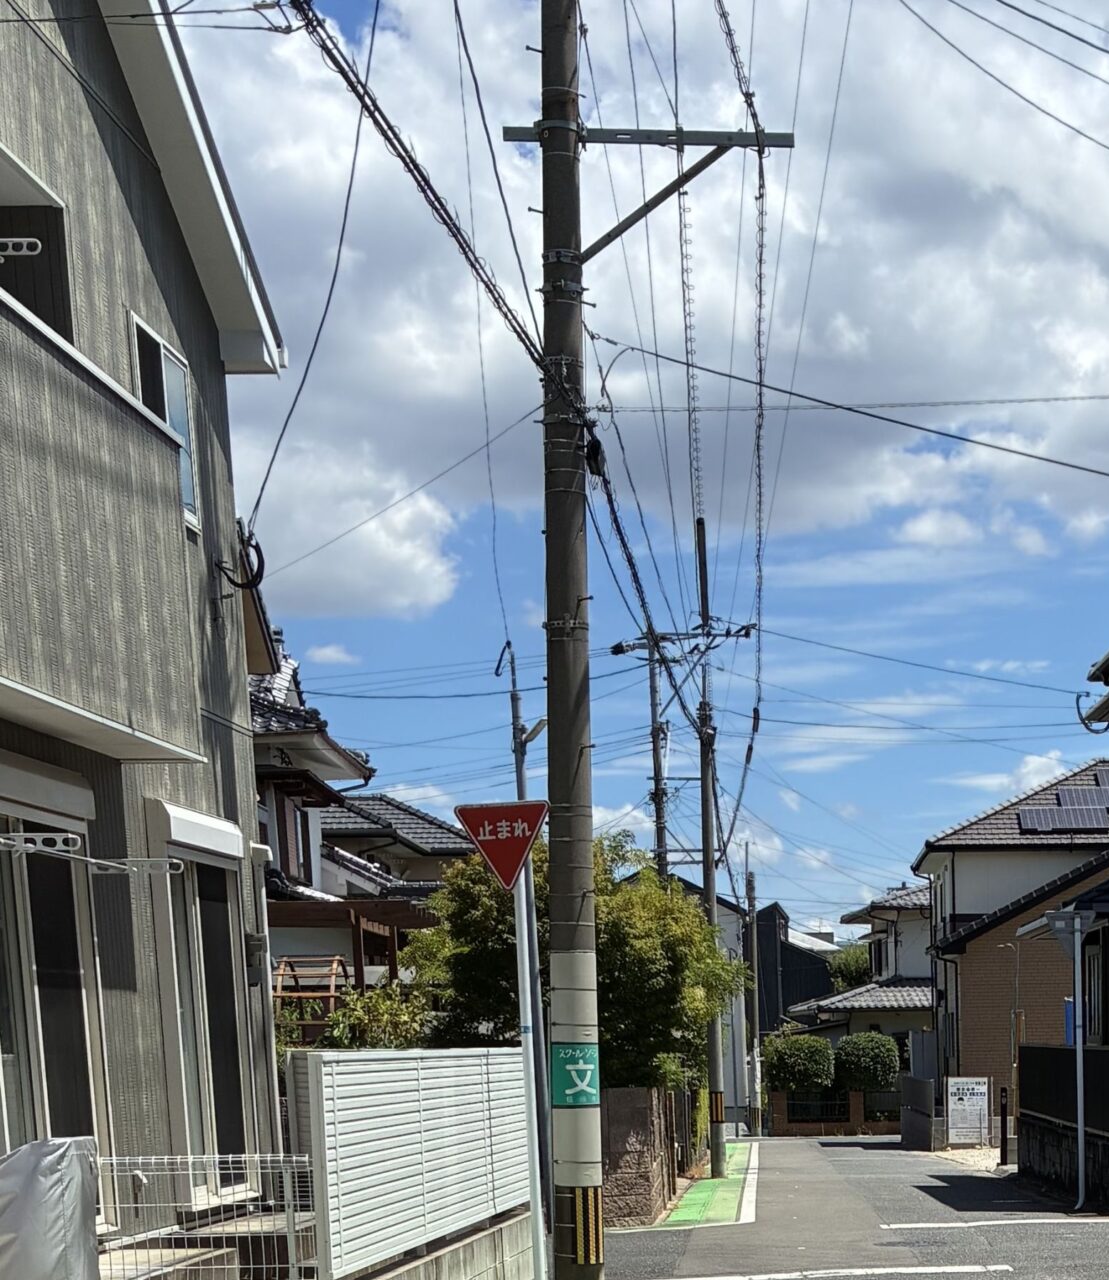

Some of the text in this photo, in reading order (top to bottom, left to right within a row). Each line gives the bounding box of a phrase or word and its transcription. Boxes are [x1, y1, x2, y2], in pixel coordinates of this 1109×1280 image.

[477, 818, 532, 840] 止まれ
[565, 1059, 597, 1095] 文
